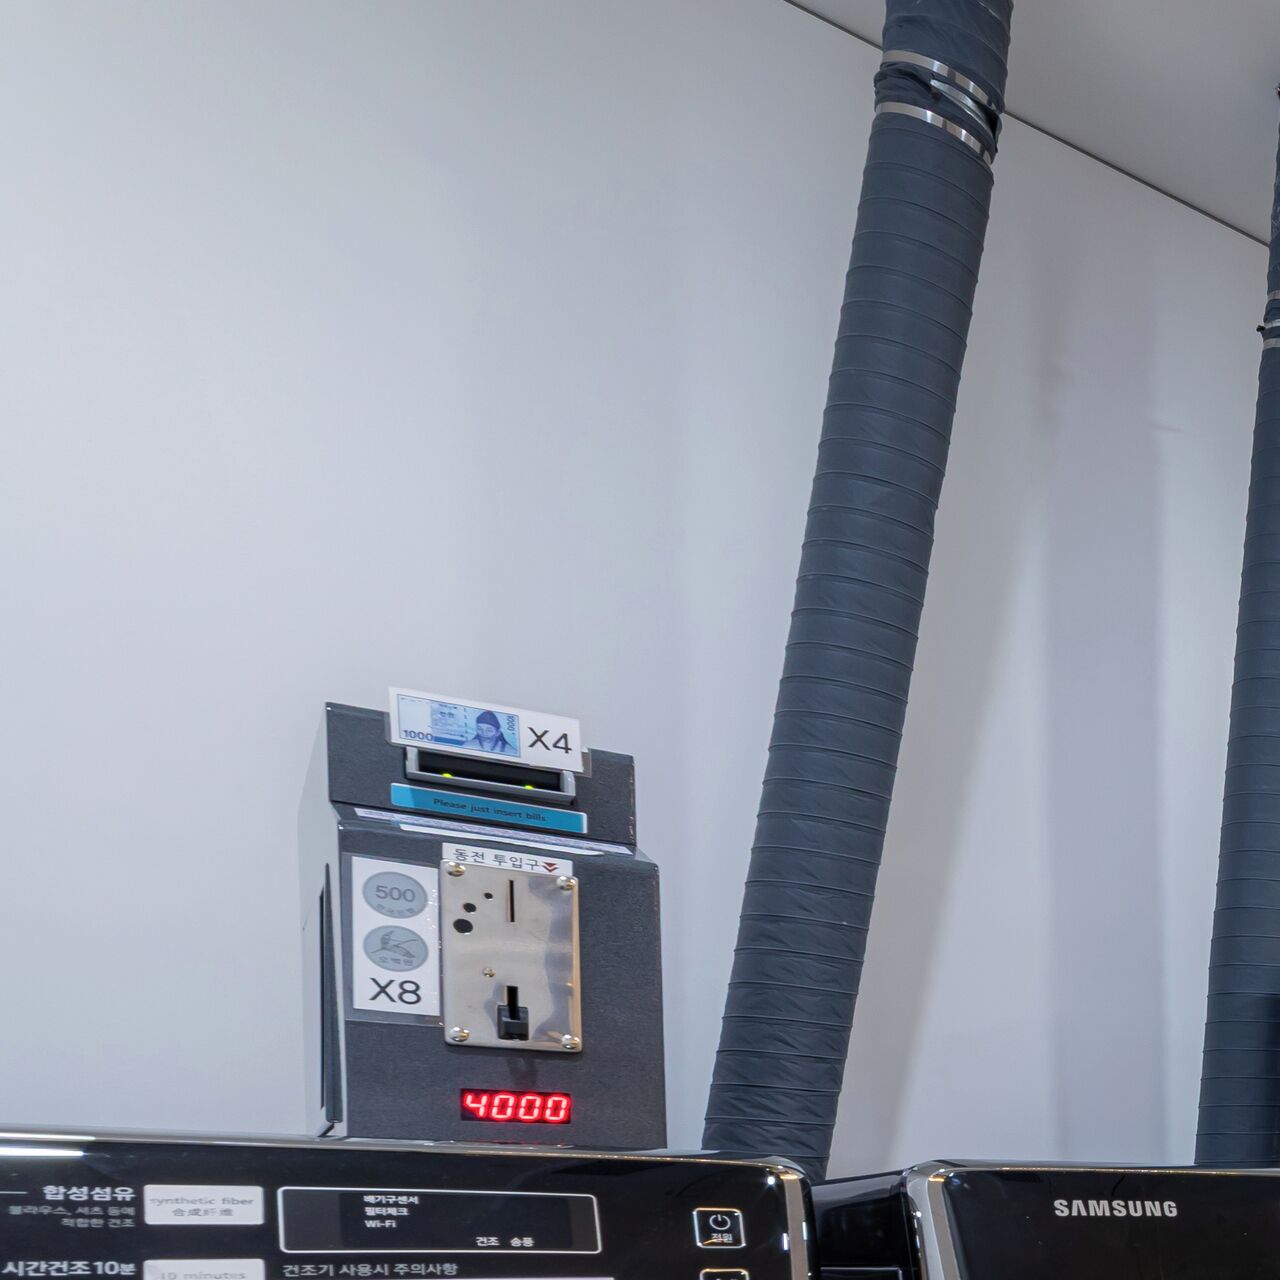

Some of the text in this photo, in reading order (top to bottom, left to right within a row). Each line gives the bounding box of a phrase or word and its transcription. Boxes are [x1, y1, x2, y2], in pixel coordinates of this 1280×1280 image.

[403, 729, 433, 741] 1000
[528, 726, 572, 754] X4
[433, 798, 545, 822] Please just insert bills
[453, 848, 539, 870] 동전 투입구
[375, 885, 416, 902] 500
[369, 977, 421, 1005] X8
[464, 1092, 570, 1123] 4000
[42, 1185, 136, 1201] 합성섬유
[222, 1196, 254, 1206] fiber
[1054, 1199, 1178, 1218] SAMSUNG
[108, 1218, 135, 1228] 건조
[364, 1219, 397, 1228] Wi-Fi
[476, 1236, 535, 1247] 건조 송풍
[1, 1261, 136, 1277] 시간건조 10분
[184, 1271, 246, 1280] minutes
[282, 1263, 459, 1277] 건조기 사용시 주의사항
